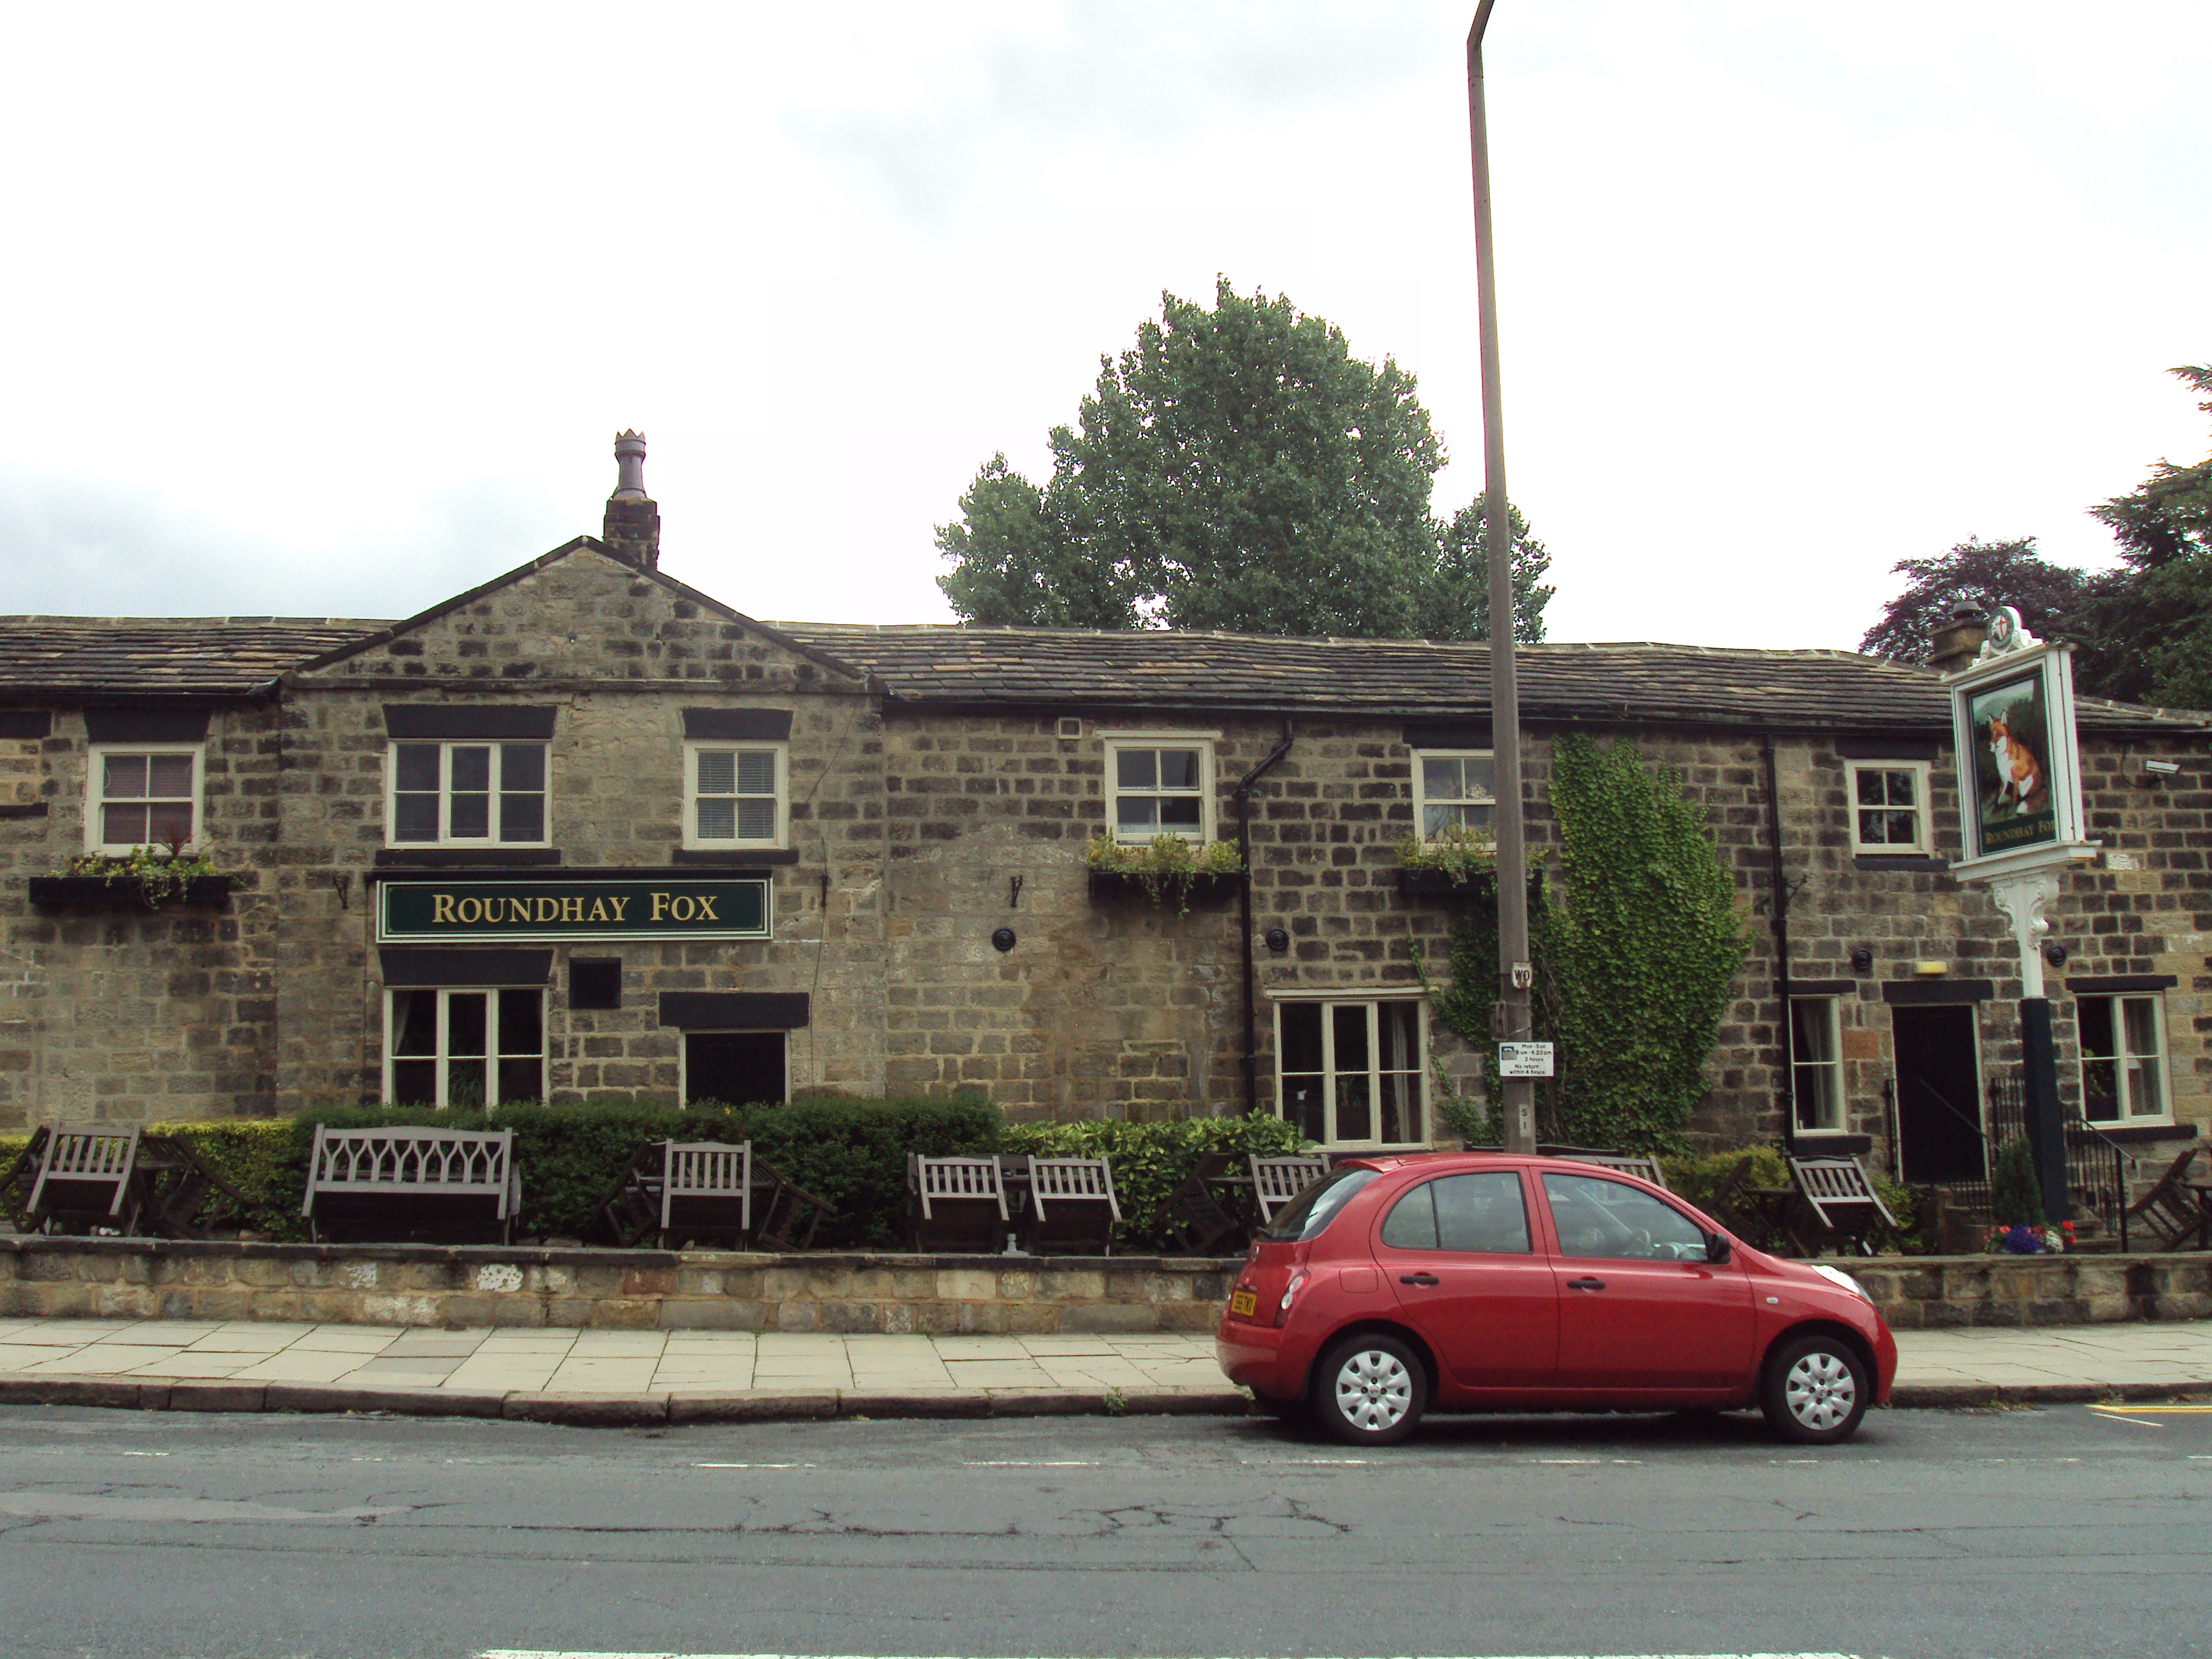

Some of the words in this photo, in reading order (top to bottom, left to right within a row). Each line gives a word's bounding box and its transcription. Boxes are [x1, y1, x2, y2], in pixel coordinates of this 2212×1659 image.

[1985, 825, 2034, 845] ROUNDHAY
[432, 894, 631, 924] ROUNDHAY
[649, 893, 720, 922] FOX
